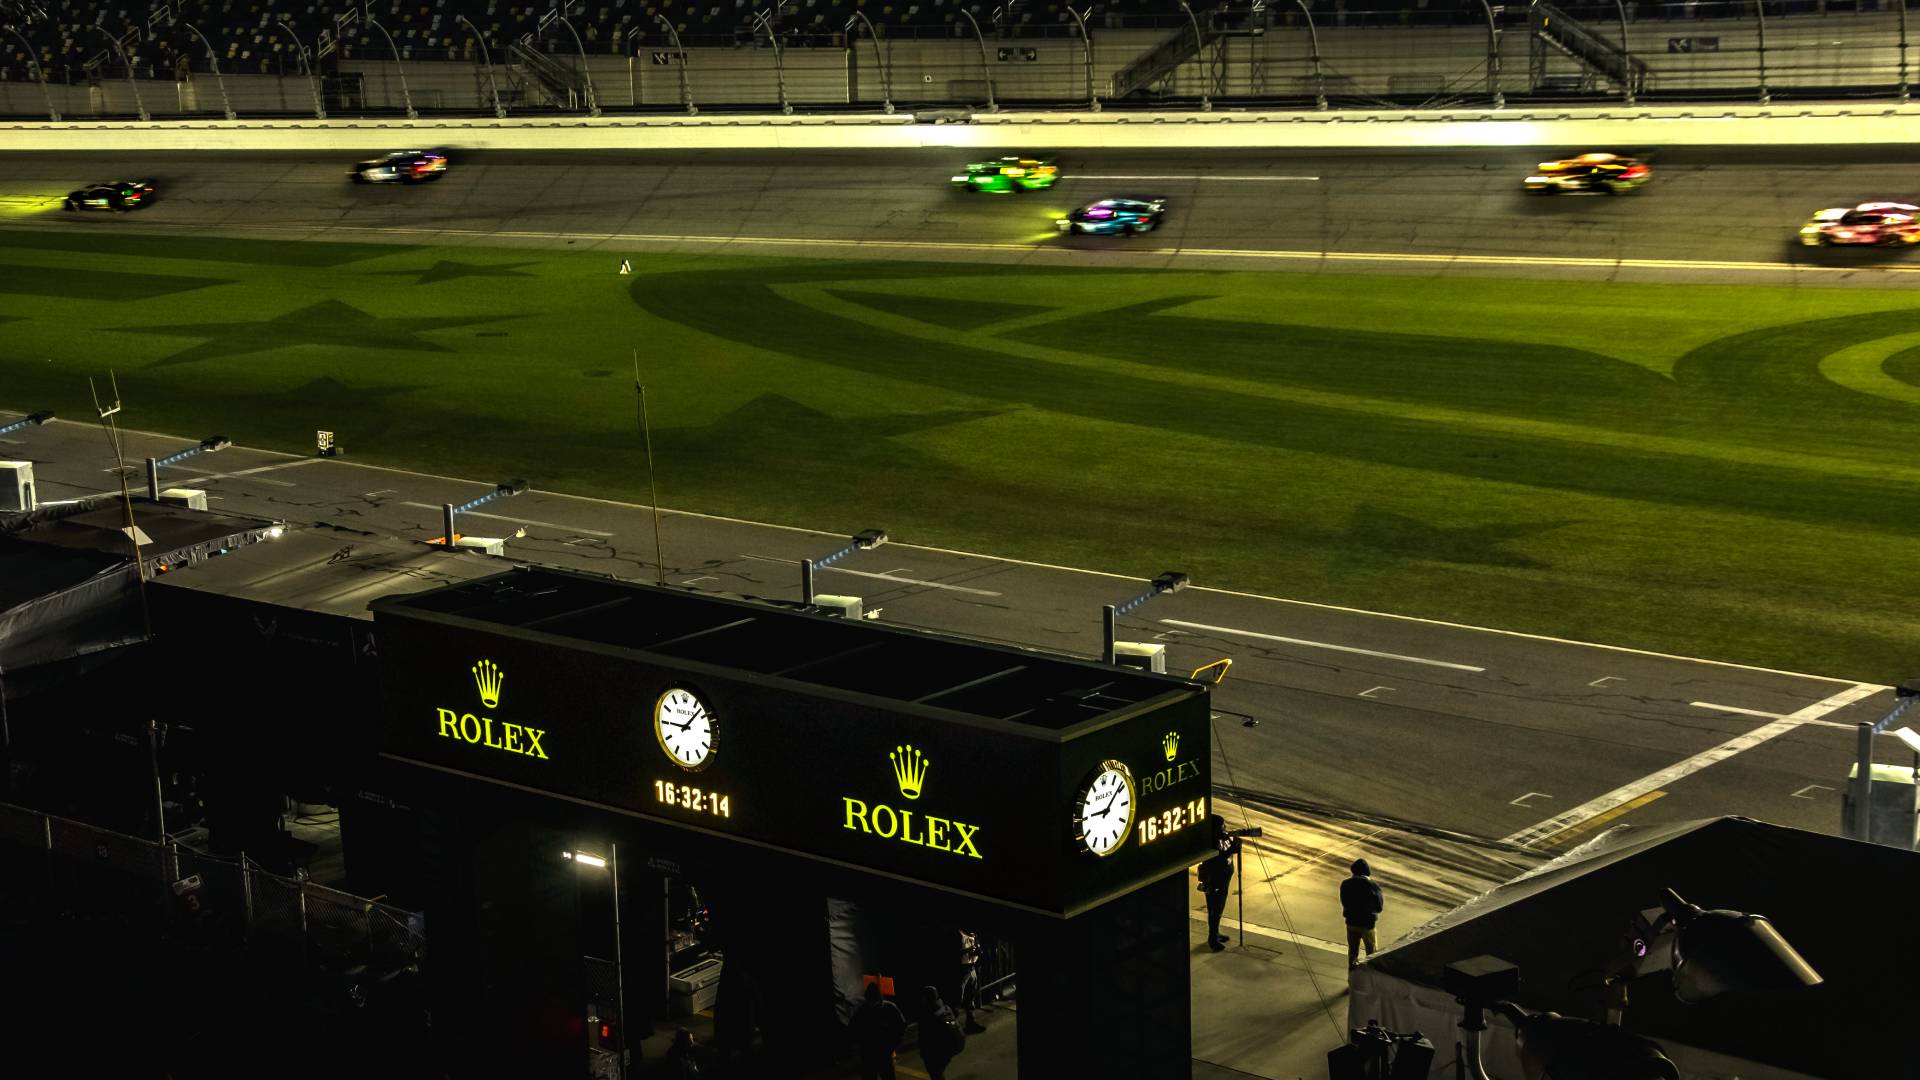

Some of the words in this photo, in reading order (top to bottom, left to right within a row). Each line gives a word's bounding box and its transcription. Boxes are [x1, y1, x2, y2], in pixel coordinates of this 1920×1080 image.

[676, 708, 695, 716] ROLEX
[436, 707, 549, 760] ROLEX
[1095, 791, 1113, 801] ROLEX
[1141, 756, 1201, 797] ROLEX
[655, 779, 730, 818] 16:32:14
[843, 796, 983, 859] ROLEX
[1138, 797, 1206, 845] 16:32:14
